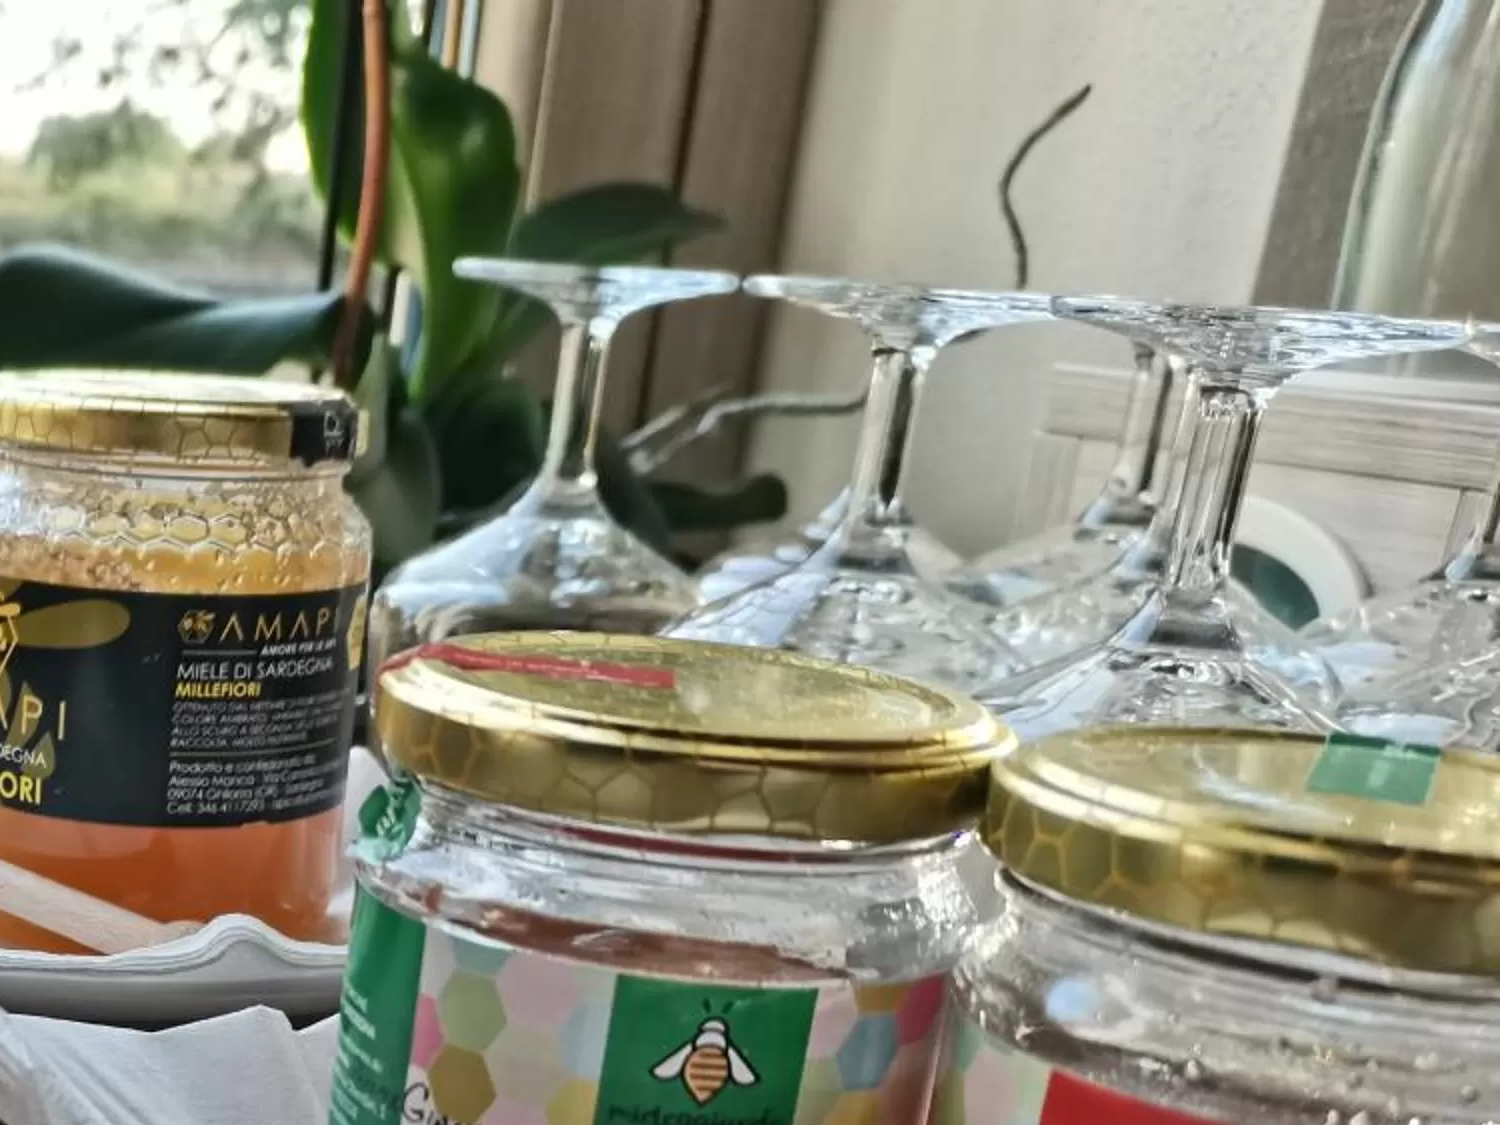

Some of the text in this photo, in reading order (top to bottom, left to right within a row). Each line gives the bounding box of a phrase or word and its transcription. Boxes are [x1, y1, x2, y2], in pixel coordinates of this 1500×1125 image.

[177, 656, 334, 680] MIELE DI SARDEGNA
[175, 681, 262, 698] MILLEFIORI
